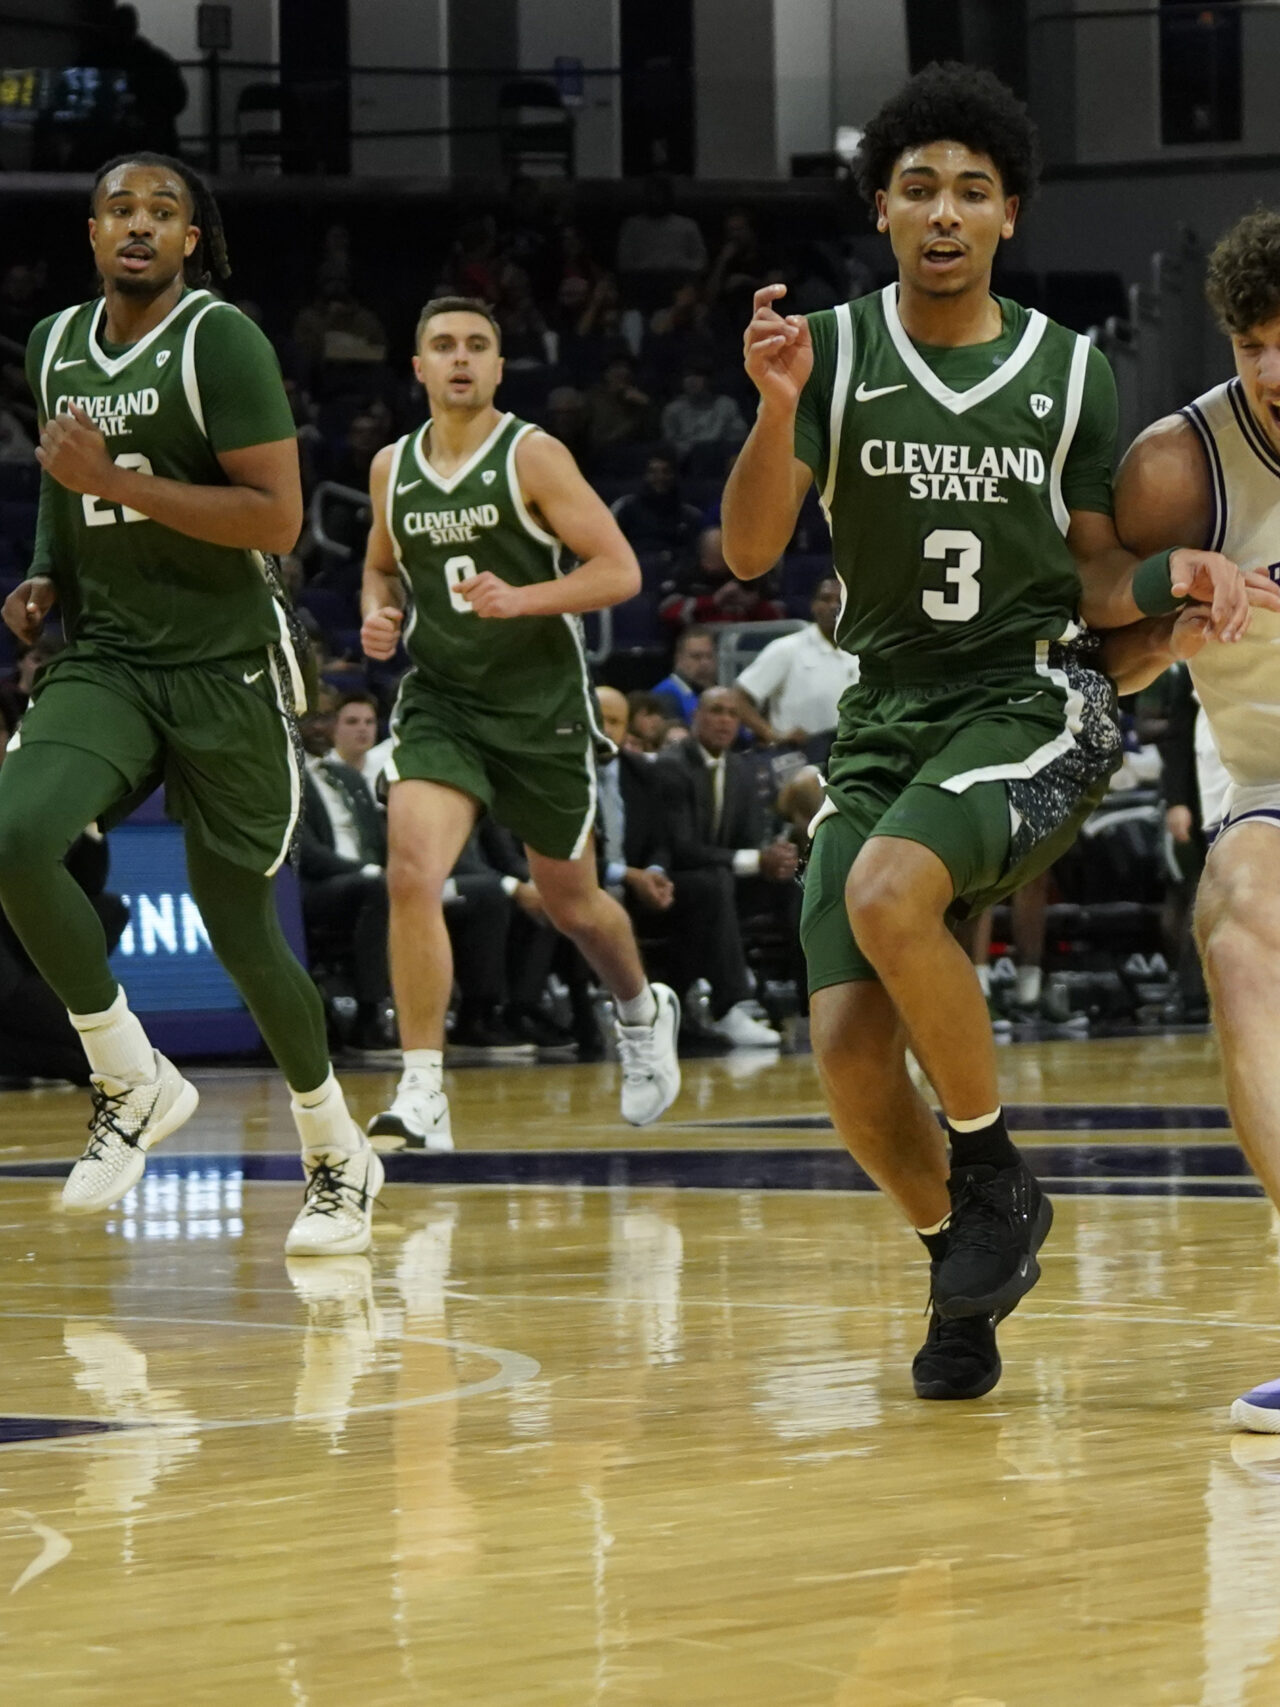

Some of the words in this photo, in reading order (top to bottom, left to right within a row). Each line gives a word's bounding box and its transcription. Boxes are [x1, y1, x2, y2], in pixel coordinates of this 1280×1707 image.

[55, 387, 160, 418] CLEVELAND
[92, 415, 130, 438] ATE
[860, 439, 1045, 485] CLEVELAND
[909, 473, 1003, 503] STATE
[404, 503, 499, 535] CLEVELAND
[429, 526, 475, 544] STATE
[922, 529, 982, 621] 3
